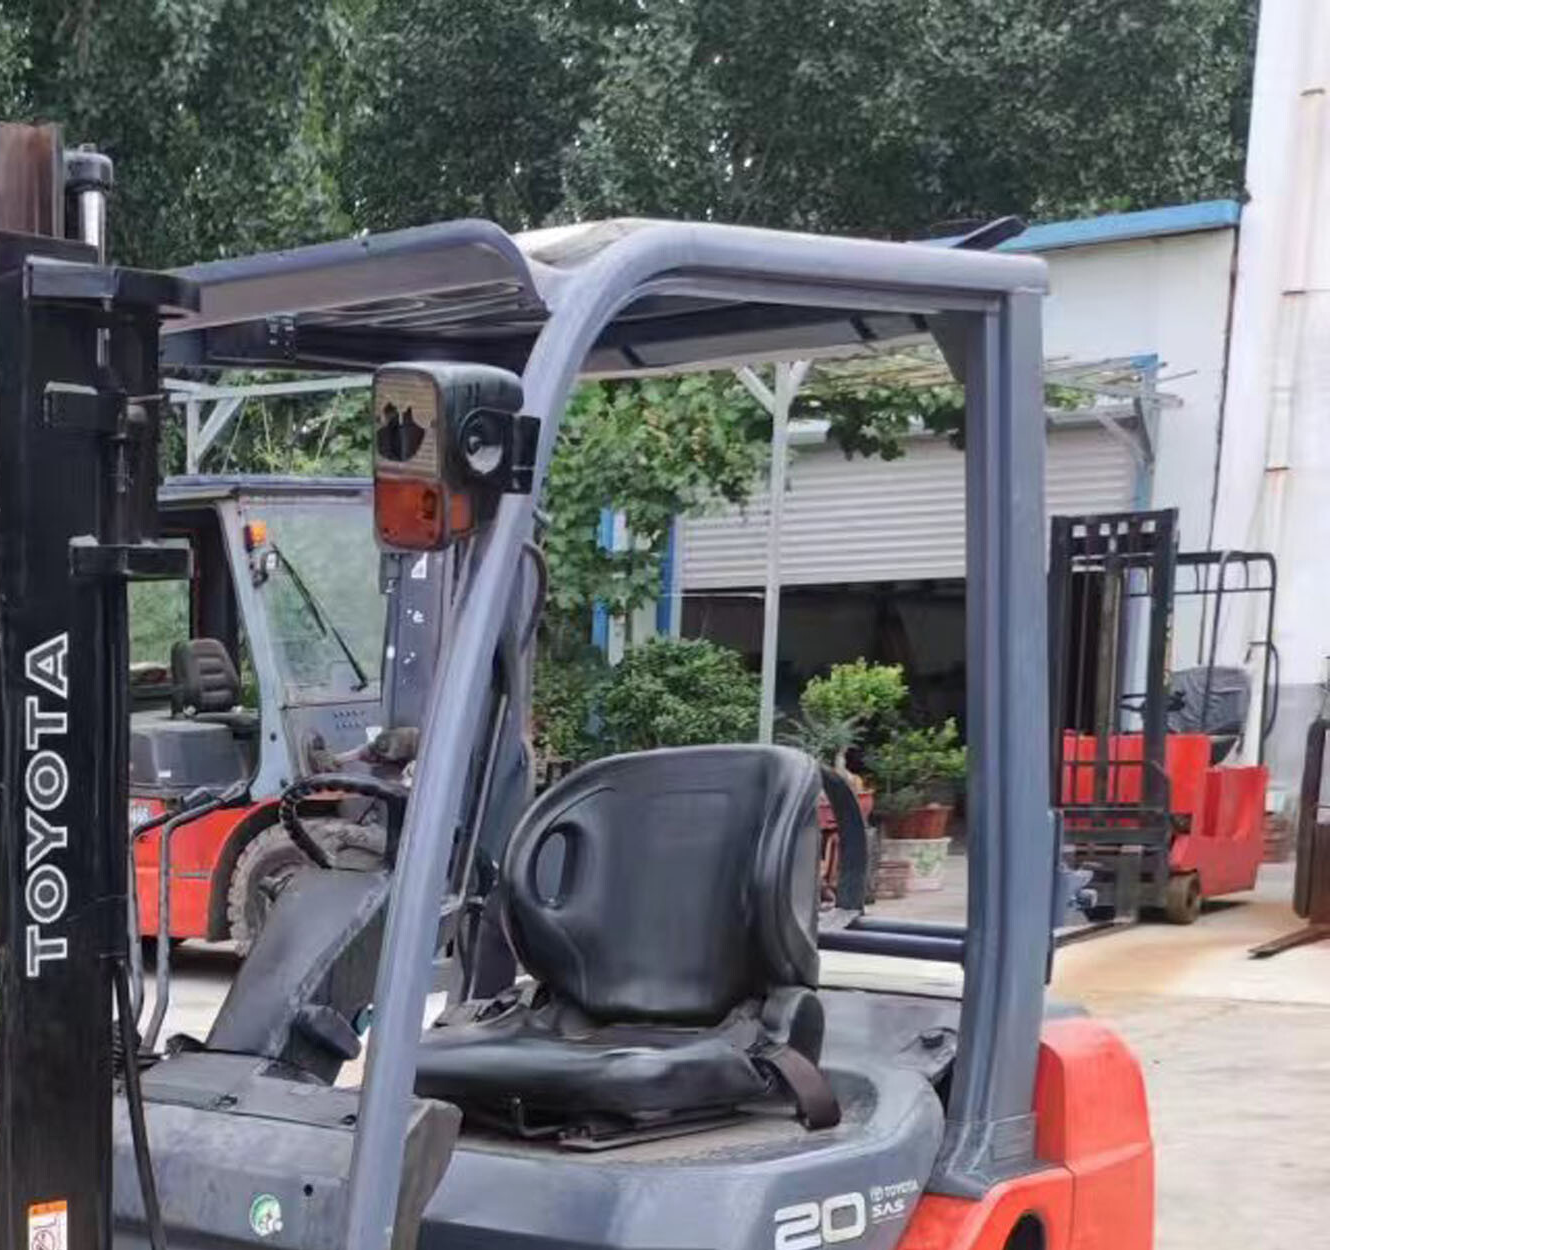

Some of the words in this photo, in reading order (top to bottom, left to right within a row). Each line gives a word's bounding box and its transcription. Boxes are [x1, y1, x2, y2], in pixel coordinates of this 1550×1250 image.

[24, 631, 69, 978] TOYOTA
[883, 1178, 920, 1197] TOYOTA
[871, 1198, 905, 1218] SAS
